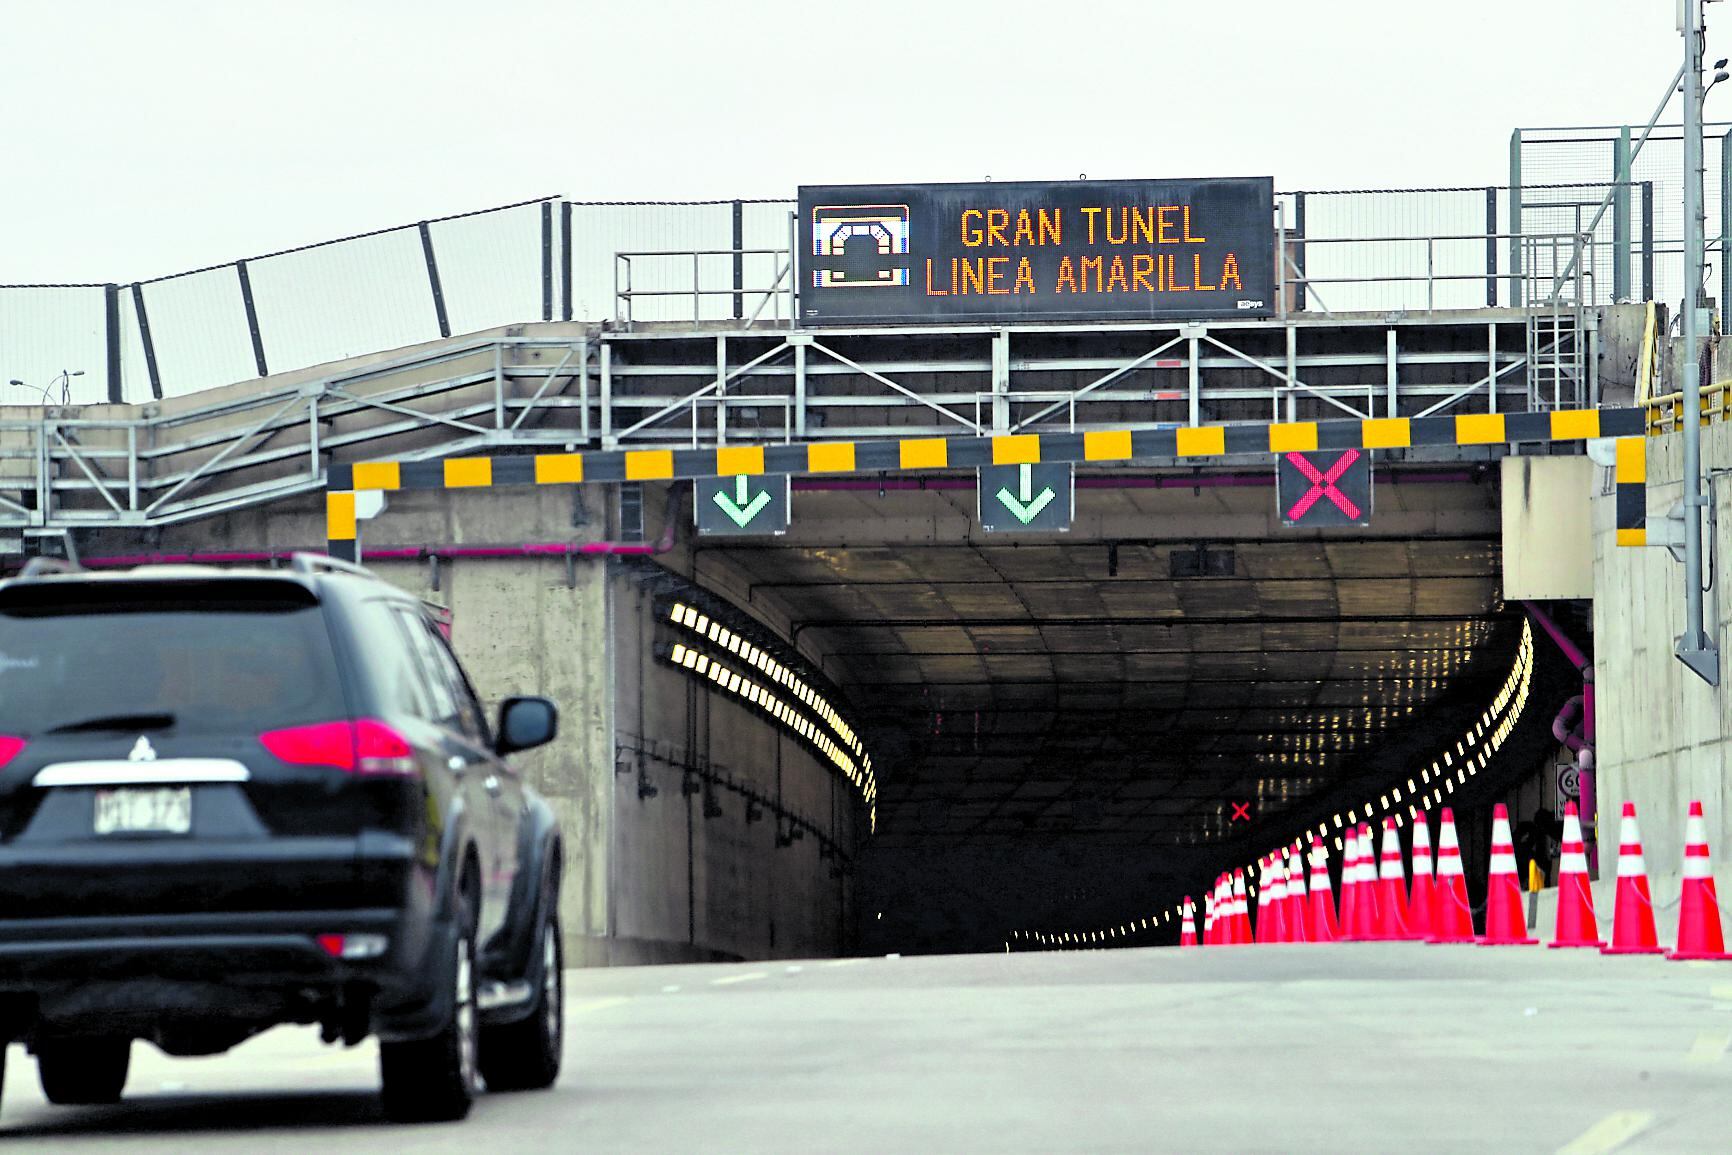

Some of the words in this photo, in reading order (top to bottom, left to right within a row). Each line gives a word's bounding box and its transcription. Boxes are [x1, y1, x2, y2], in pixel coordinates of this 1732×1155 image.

[961, 209, 1062, 247] GRAN
[1080, 205, 1206, 245] TUNEL
[926, 257, 1036, 296] LINEA
[1055, 253, 1242, 293] AMARILLA
